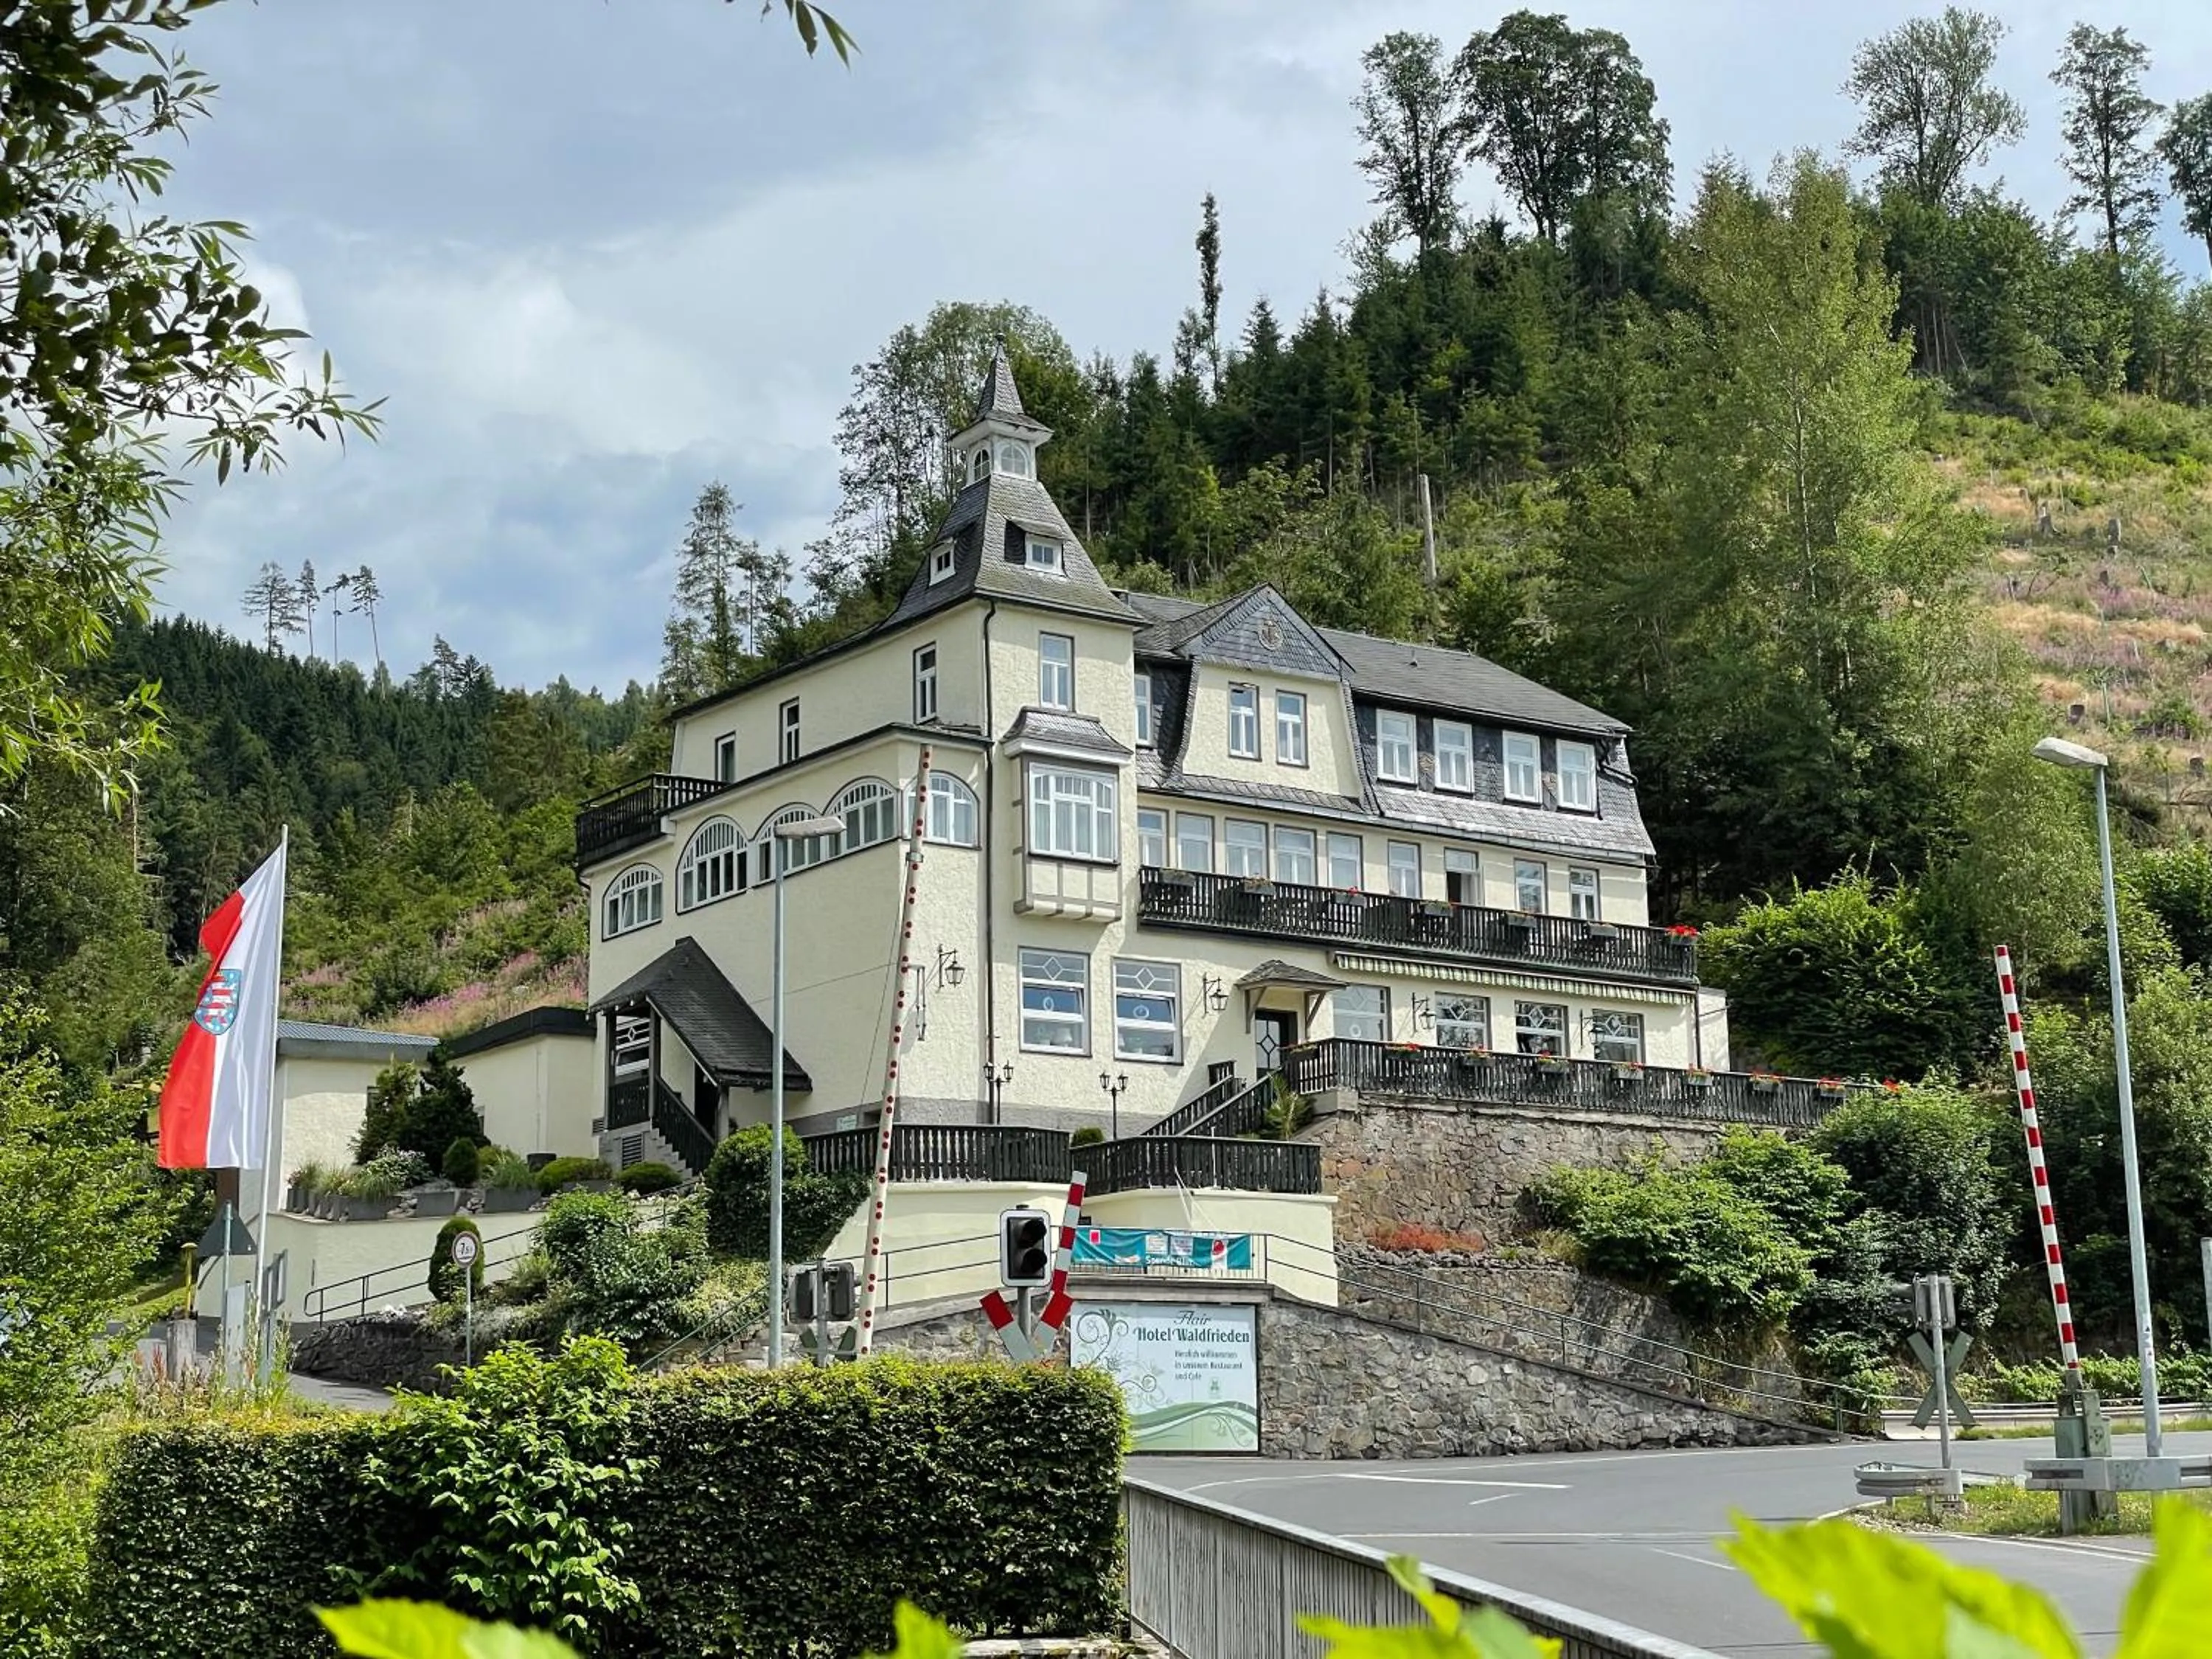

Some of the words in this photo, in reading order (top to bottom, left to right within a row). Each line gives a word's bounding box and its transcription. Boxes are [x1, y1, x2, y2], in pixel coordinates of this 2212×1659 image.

[1173, 1310, 1211, 1325] Flair
[1133, 1327, 1171, 1341] Hotel
[1172, 1327, 1250, 1343] Waldfrieden
